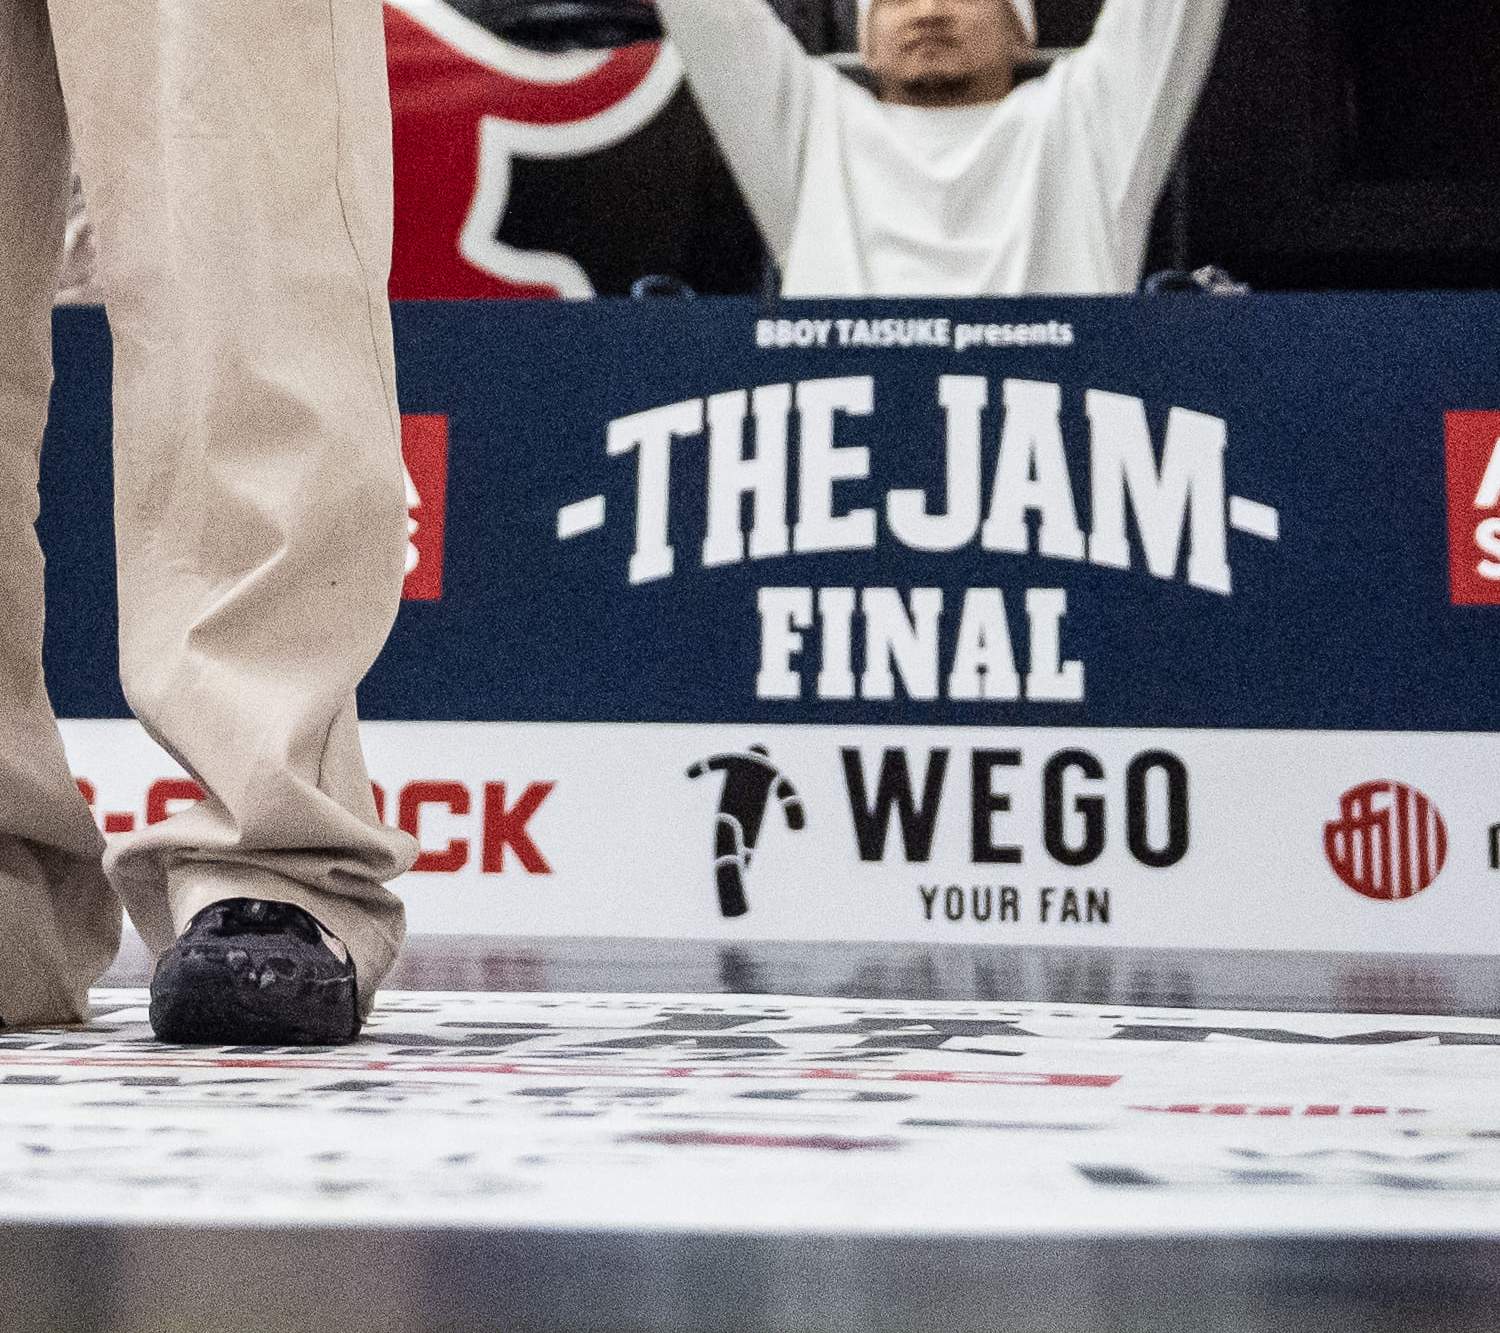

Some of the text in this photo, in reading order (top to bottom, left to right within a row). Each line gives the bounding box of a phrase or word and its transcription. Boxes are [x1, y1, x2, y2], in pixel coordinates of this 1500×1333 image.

[755, 318, 1075, 352] BBOY TAISUKE presents
[556, 373, 1280, 597] -THE JAM-
[755, 585, 1086, 703] FINAL
[840, 745, 1190, 869] WEGO
[918, 884, 1111, 925] YOUR FAN
